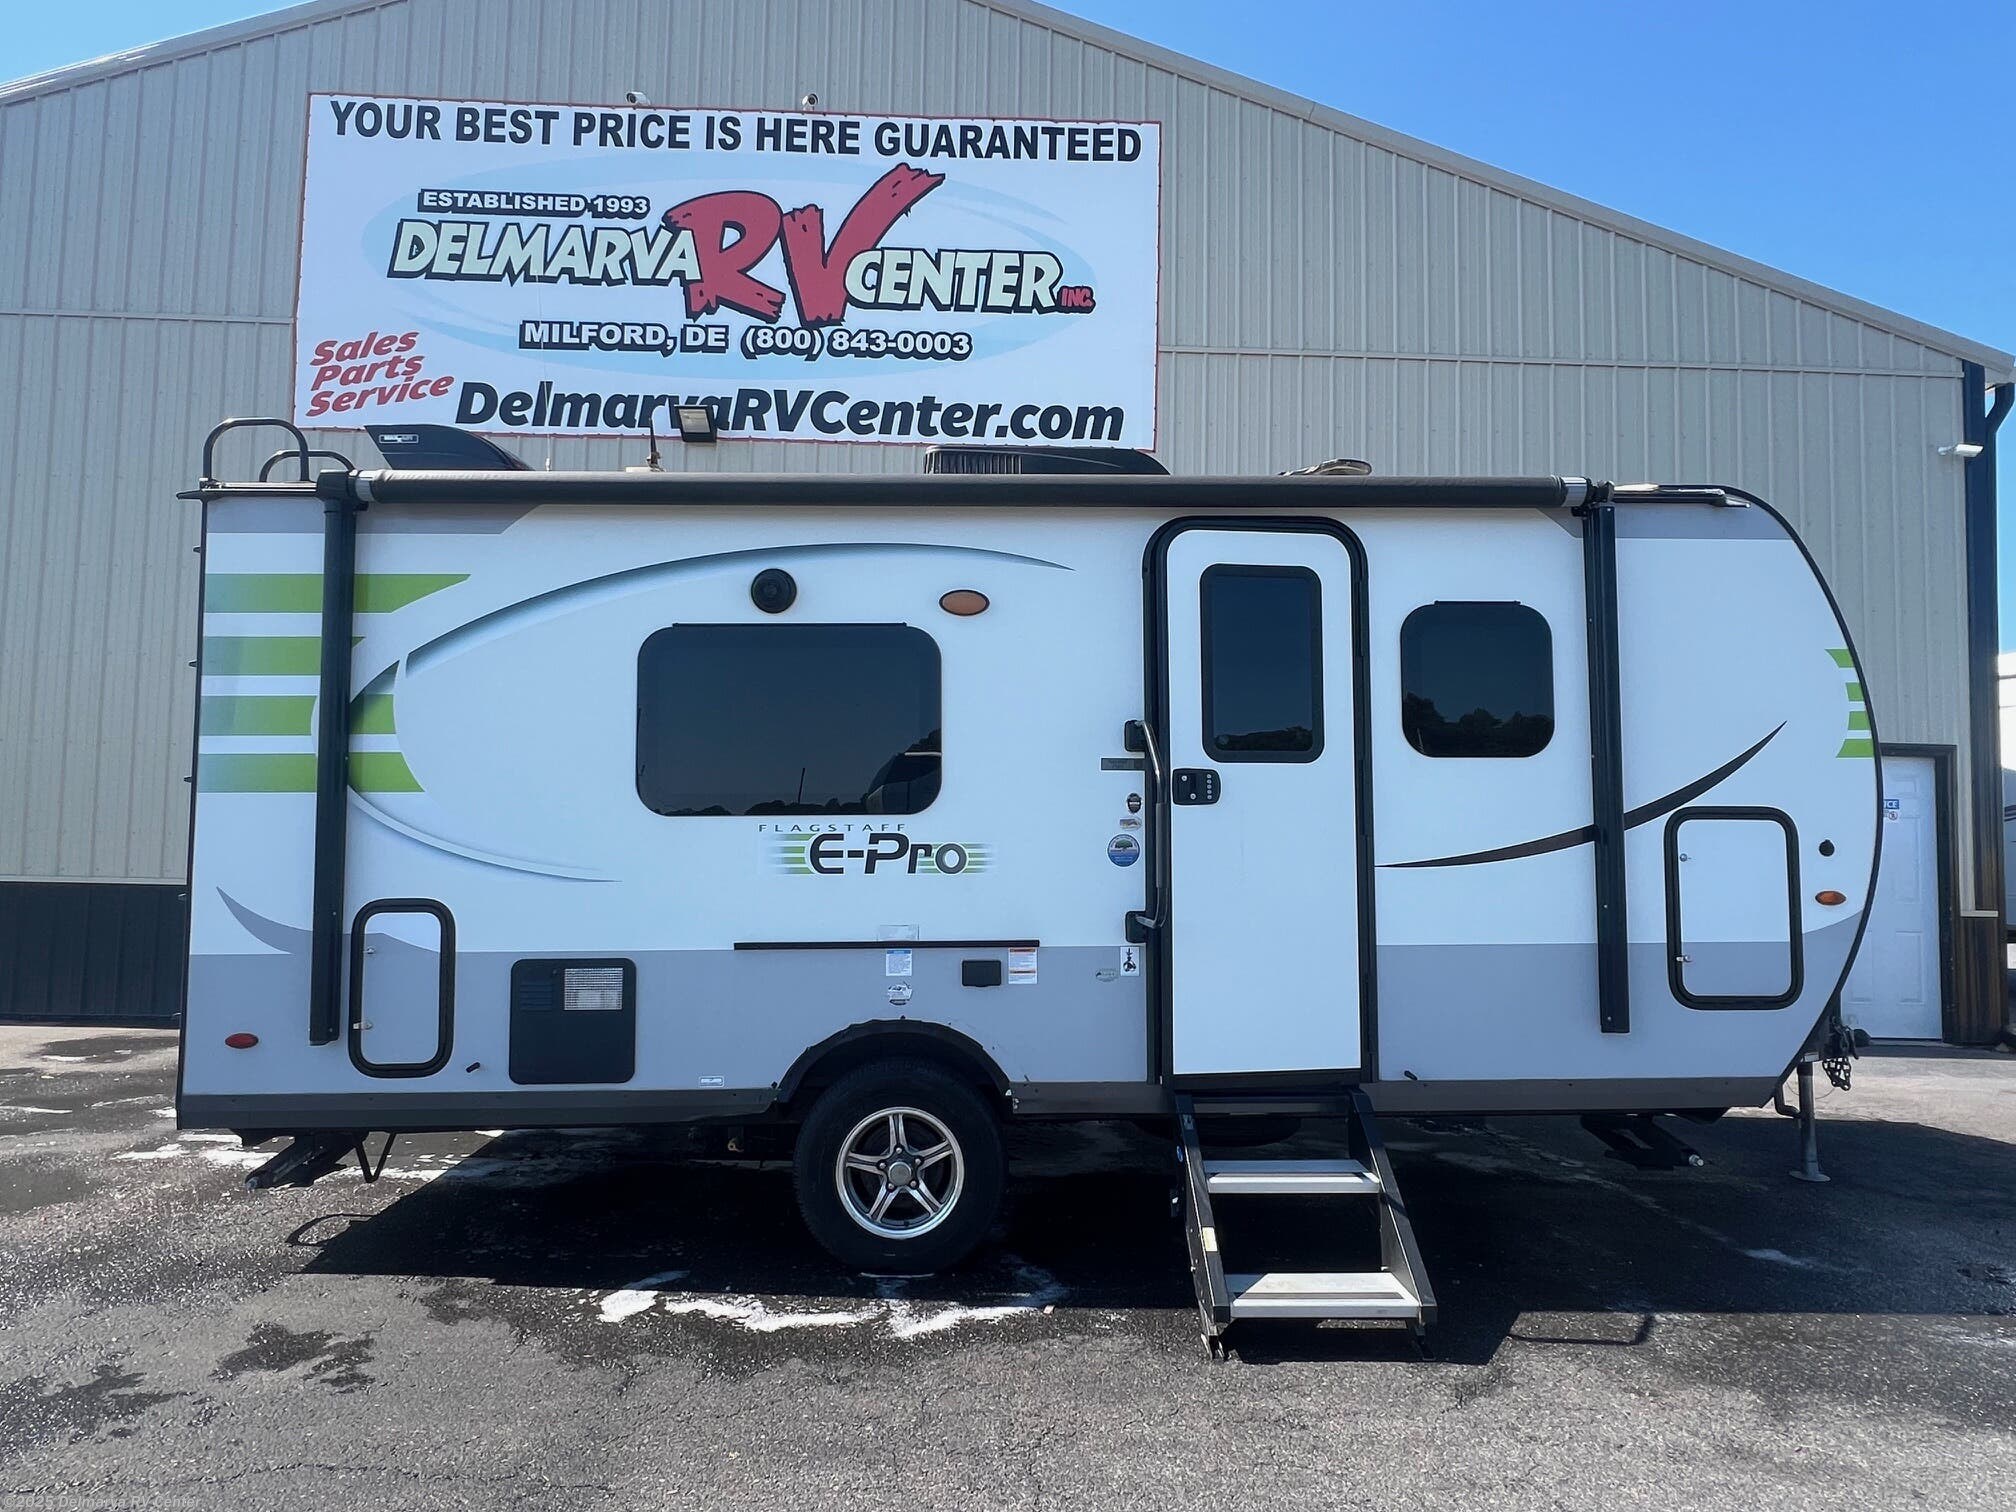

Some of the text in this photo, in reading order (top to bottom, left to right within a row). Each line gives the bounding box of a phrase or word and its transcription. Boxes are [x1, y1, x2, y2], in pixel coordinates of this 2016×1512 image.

[330, 100, 1142, 162] YOUR BEST PRICE IS HERE GUARANTEED
[422, 190, 650, 215] ESTABLISHED 1993
[389, 162, 1096, 325] DELMARVA RV CENTER INC.
[309, 331, 420, 366] Sales
[523, 322, 971, 355] MILFORD, DE (800) 843-0003
[310, 354, 425, 391] Parts
[305, 376, 455, 417] Service
[455, 380, 1124, 441] DelmarvaRVCenter.com
[758, 823, 905, 832] FLAGSTAFF
